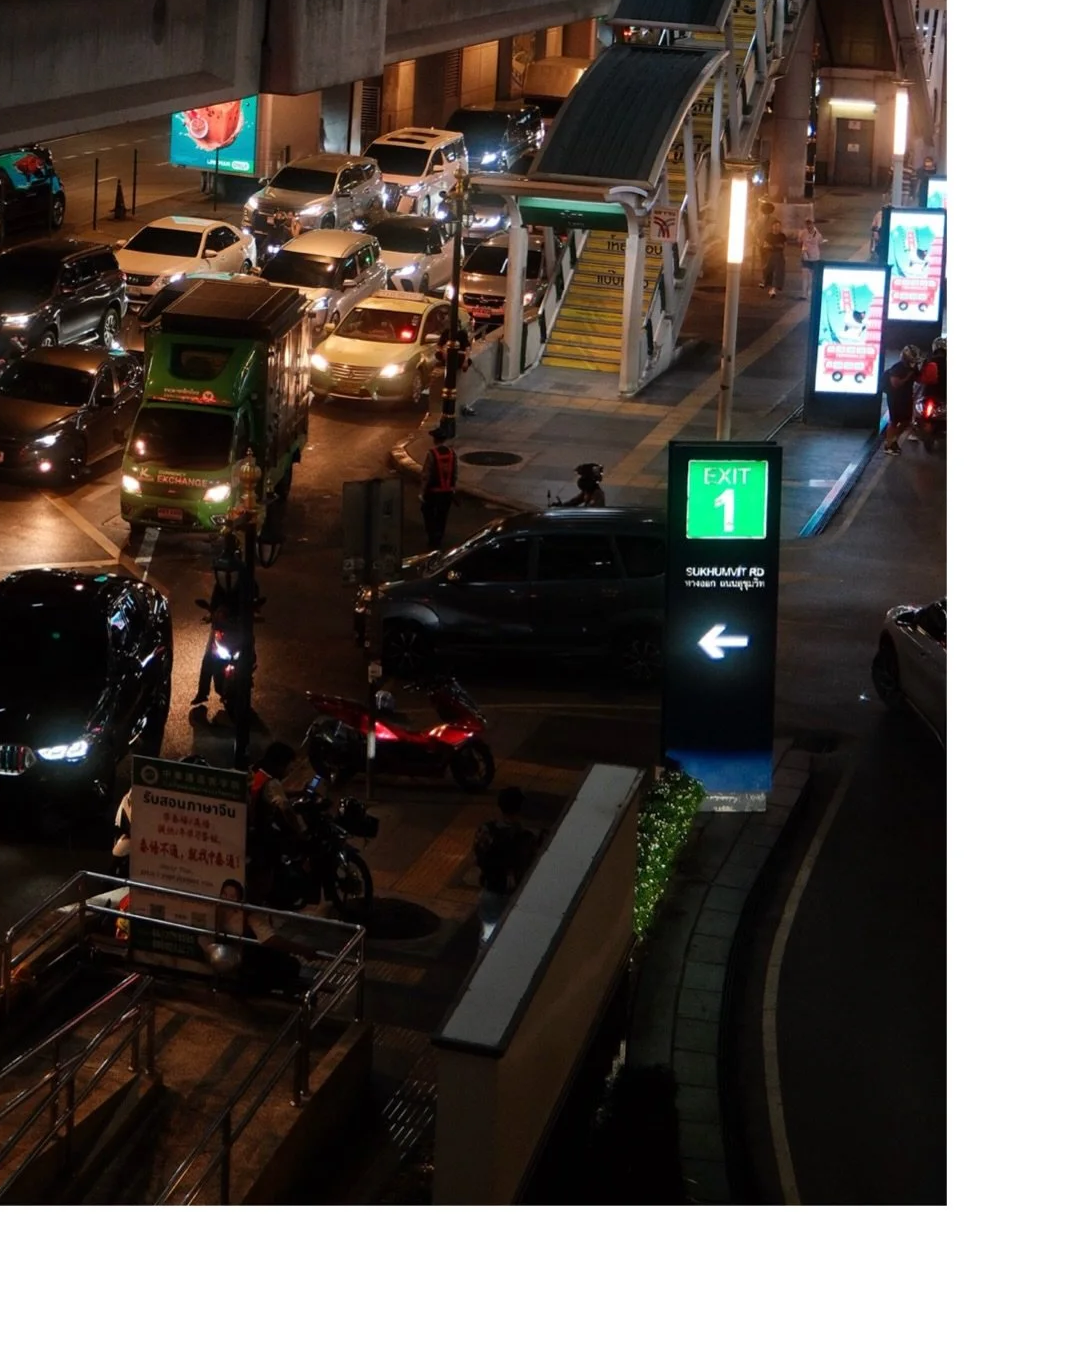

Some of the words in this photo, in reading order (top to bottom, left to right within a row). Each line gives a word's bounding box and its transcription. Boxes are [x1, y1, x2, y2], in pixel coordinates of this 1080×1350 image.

[156, 474, 209, 487] EXCHANGE
[703, 467, 751, 485] EXIT
[713, 488, 736, 533] 1
[685, 566, 747, 577] SUKHUMVIT
[749, 567, 765, 577] RD
[143, 790, 236, 819] รับสอนภาษาจีน
